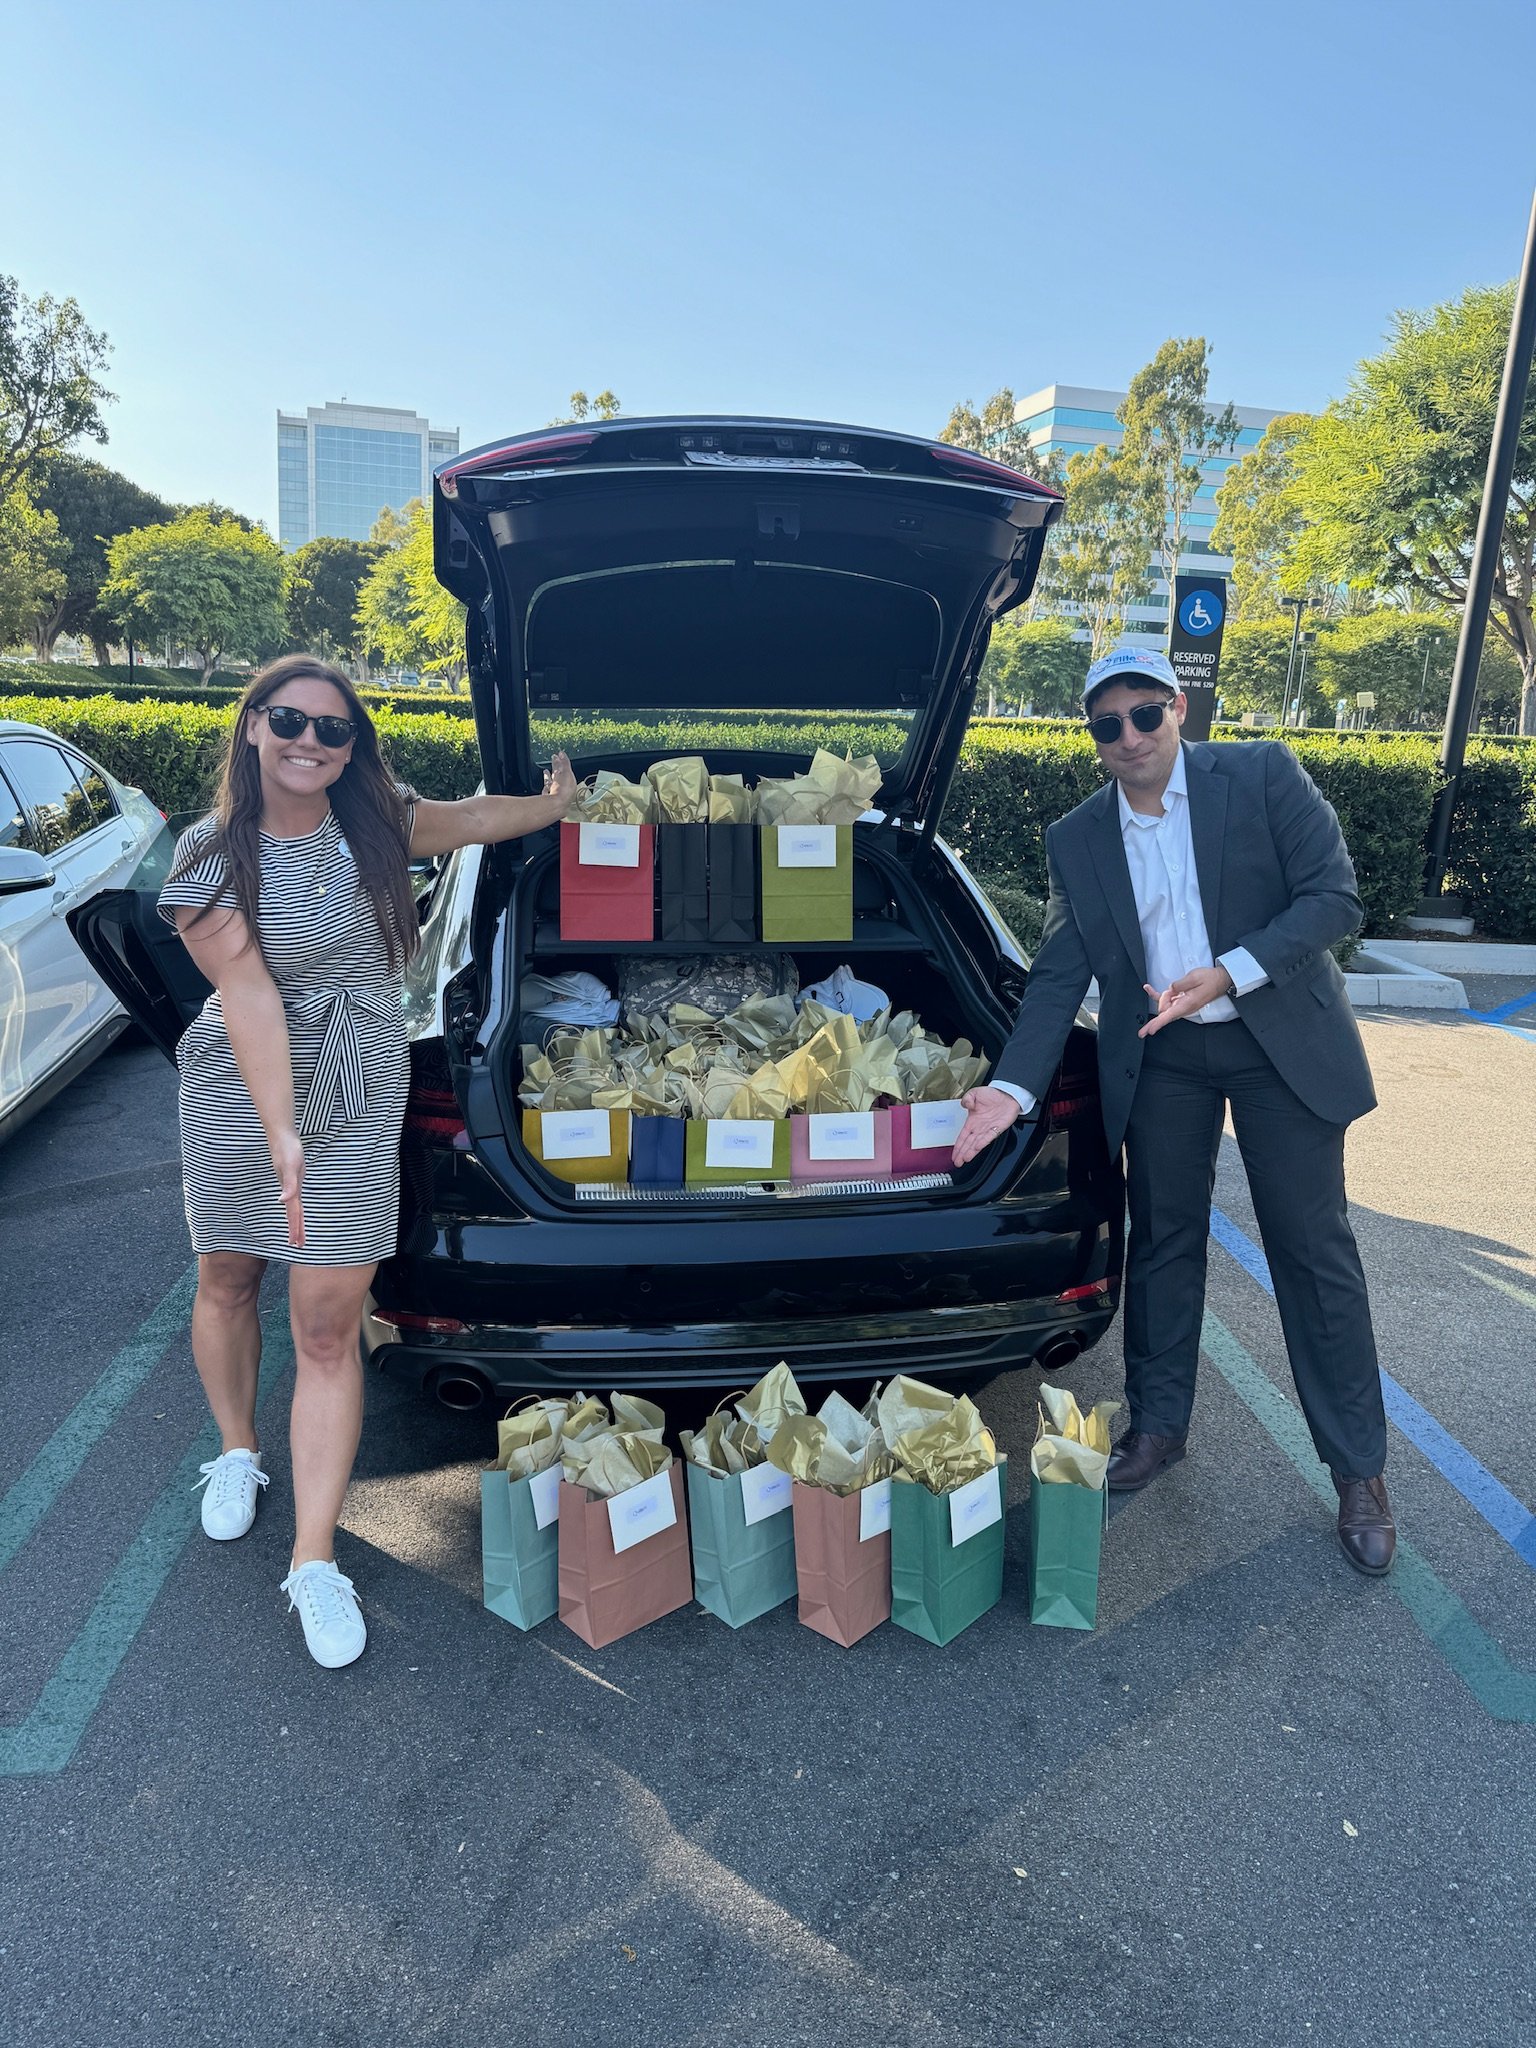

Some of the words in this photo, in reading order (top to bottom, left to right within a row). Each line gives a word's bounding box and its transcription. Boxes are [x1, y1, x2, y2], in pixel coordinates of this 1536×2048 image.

[1173, 652, 1216, 664] RESERVED
[1174, 665, 1211, 678] PARKING
[1202, 681, 1215, 689] $250
